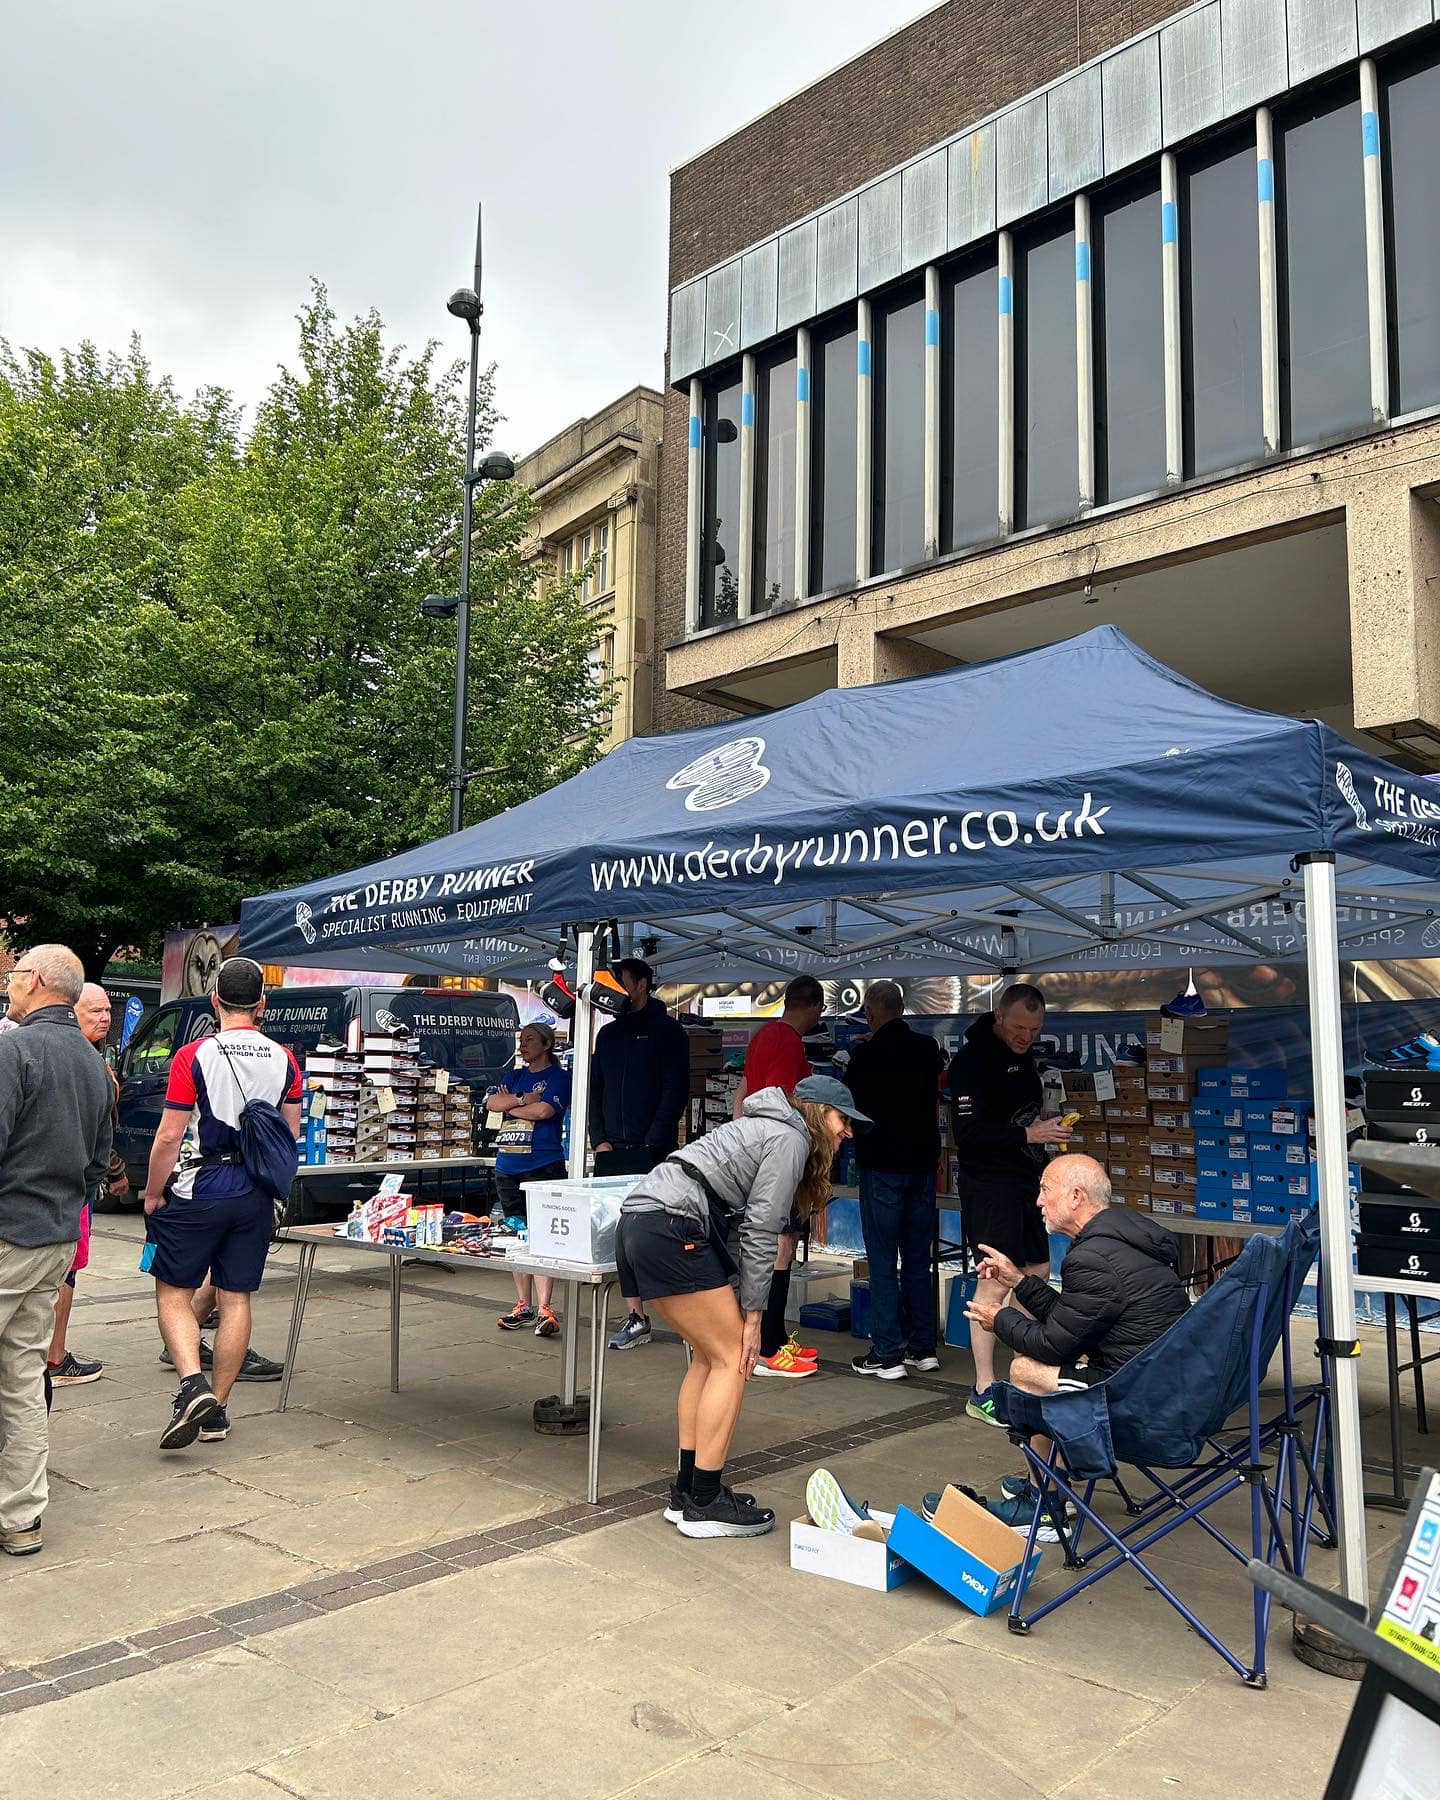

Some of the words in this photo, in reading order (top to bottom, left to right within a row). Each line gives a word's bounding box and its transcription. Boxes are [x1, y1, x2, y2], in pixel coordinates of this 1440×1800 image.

[1373, 775, 1408, 817] THE
[590, 792, 1112, 892] www.derbyrunner.co.uk
[365, 875, 435, 905] DERBY
[438, 859, 535, 896] RUNNER
[321, 917, 387, 938] SPECIALIST
[391, 906, 447, 927] RUNNING
[456, 893, 533, 920] EQUIPMENT
[284, 1007, 328, 1021] RUNNER
[290, 1023, 326, 1034] EQUIPMENT
[413, 1014, 437, 1026] THE
[439, 1015, 474, 1028] DERBY
[476, 1016, 515, 1030] RUNNER
[414, 1027, 451, 1036] SPECIALIST
[455, 1028, 483, 1037] RUNNING
[1202, 1080, 1218, 1088] HOKA
[1253, 1143, 1271, 1152] HOKA
[1257, 1175, 1275, 1183] HOKA
[1257, 1205, 1275, 1213] HOKA
[550, 1216, 570, 1236] £5
[1400, 1268, 1429, 1276] SCOTT
[961, 1571, 989, 1597] HOKA
